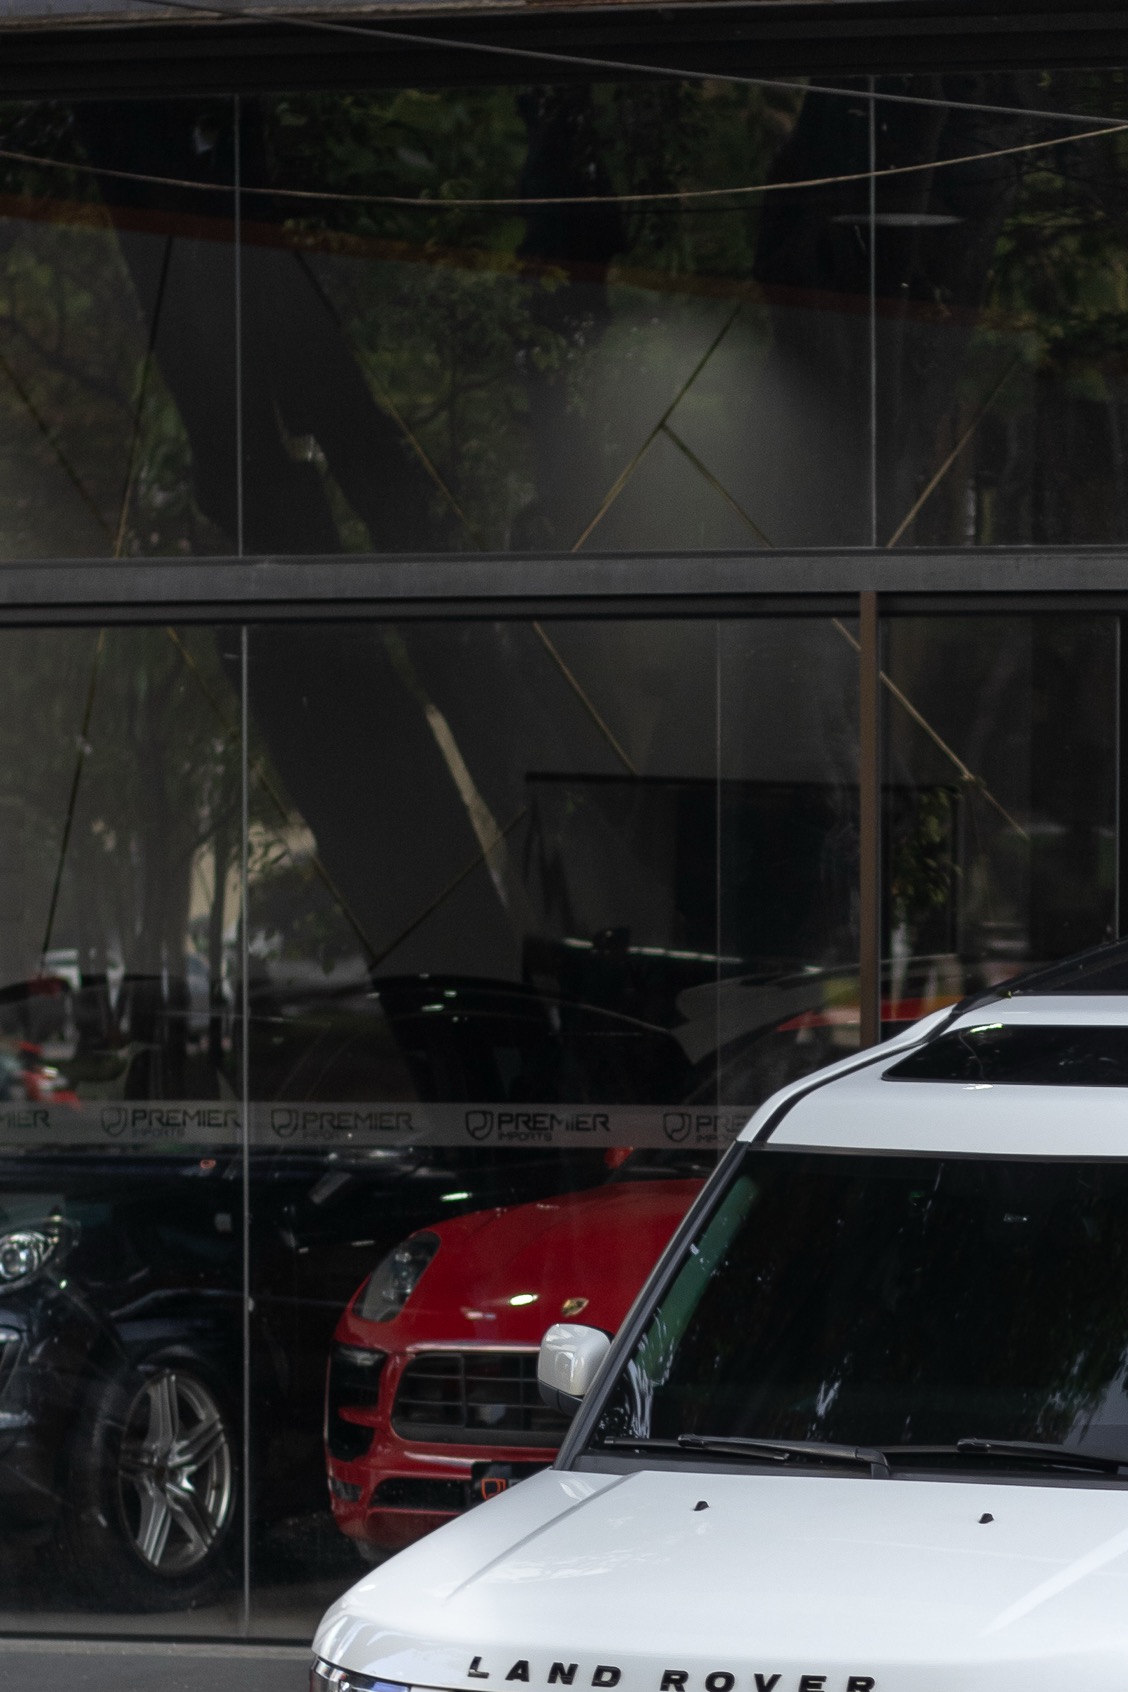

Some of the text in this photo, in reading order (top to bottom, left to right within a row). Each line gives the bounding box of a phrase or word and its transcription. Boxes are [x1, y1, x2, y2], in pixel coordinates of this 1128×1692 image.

[131, 1109, 241, 1128] PREMIER
[303, 1111, 414, 1130] PREMIER
[498, 1113, 610, 1132] PREMIER
[498, 1131, 553, 1141] IMPORTS
[467, 1655, 622, 1688] LAND
